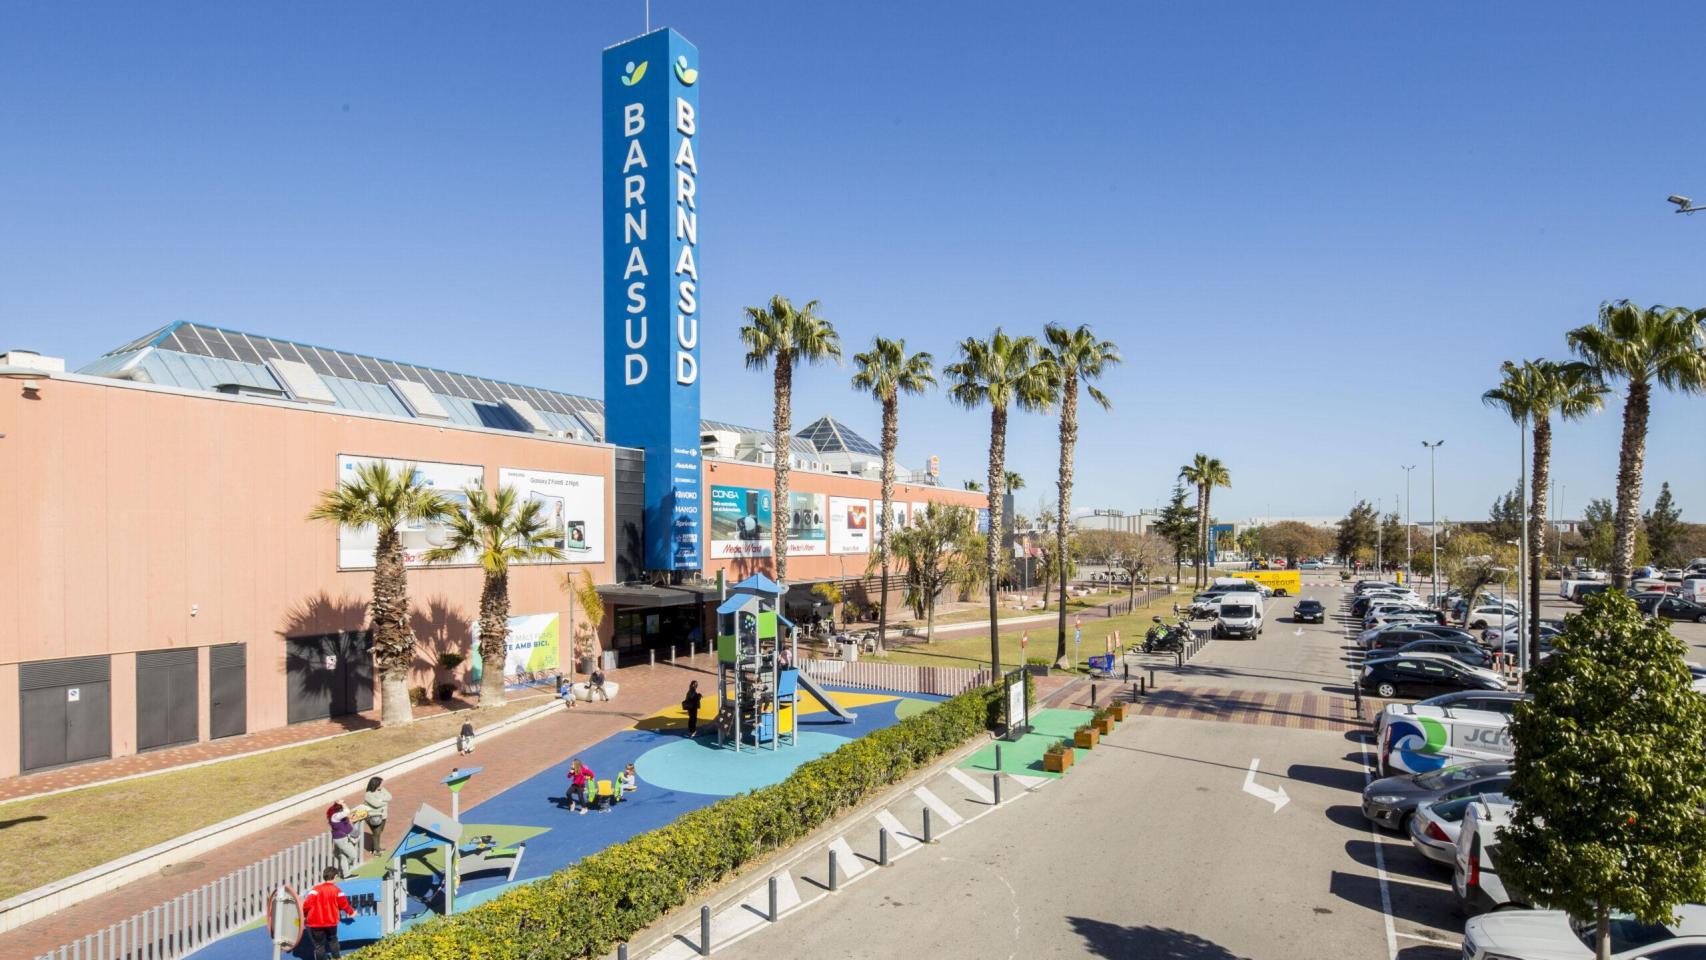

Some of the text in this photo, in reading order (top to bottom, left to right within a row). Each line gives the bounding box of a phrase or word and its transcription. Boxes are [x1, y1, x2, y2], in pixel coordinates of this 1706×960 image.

[623, 103, 648, 386] BARNASUD
[675, 97, 698, 386] BARNASUD
[712, 489, 739, 499] CONGA
[675, 506, 698, 514] MANGO
[515, 642, 532, 650] AMB
[1464, 728, 1510, 747] JCR
